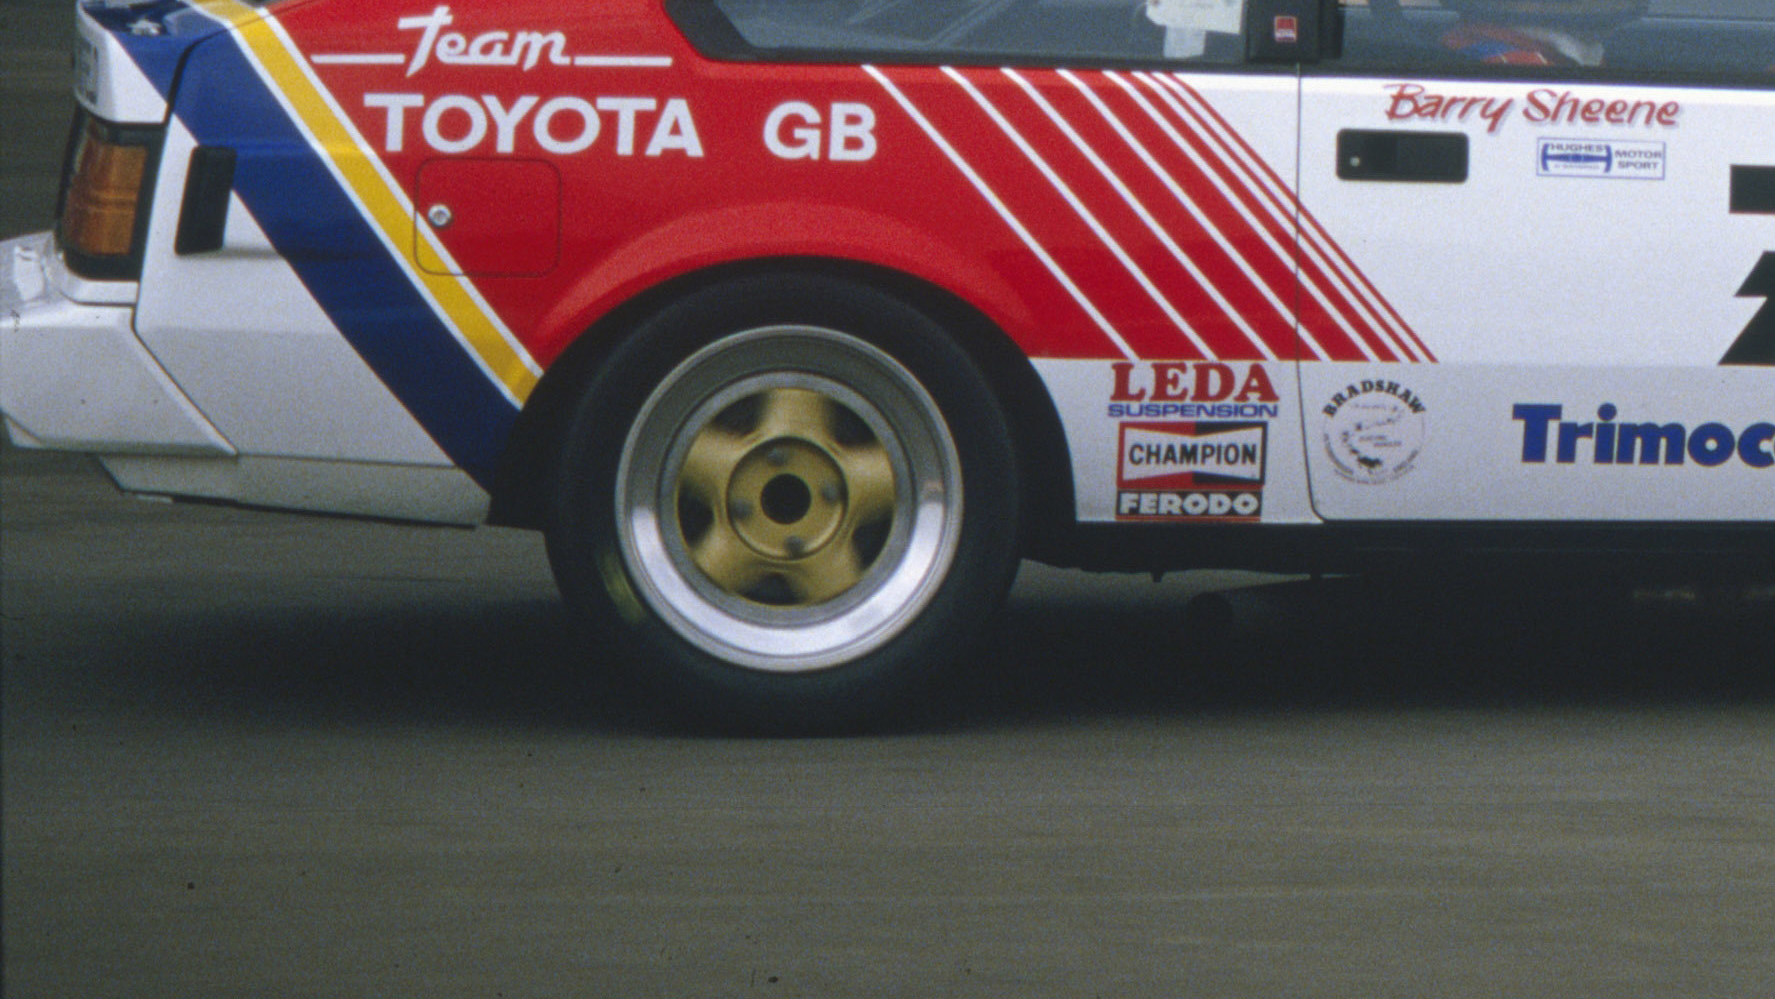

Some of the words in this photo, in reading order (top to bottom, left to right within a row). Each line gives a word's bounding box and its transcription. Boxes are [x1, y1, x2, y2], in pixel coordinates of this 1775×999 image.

[398, 6, 571, 77] Team
[1383, 83, 1514, 134] Barry
[1522, 88, 1680, 126] Sheene
[364, 93, 704, 157] TOYOTA
[763, 102, 878, 161] GB
[1614, 149, 1662, 159] MOTOR
[1617, 161, 1659, 170] SPORT
[1110, 362, 1280, 402] LEDA
[1107, 404, 1279, 418] SUSPENSION
[1322, 380, 1426, 418] BRADSHAW
[1129, 444, 1257, 465] CHAMPION
[1119, 492, 1259, 515] FERODO
